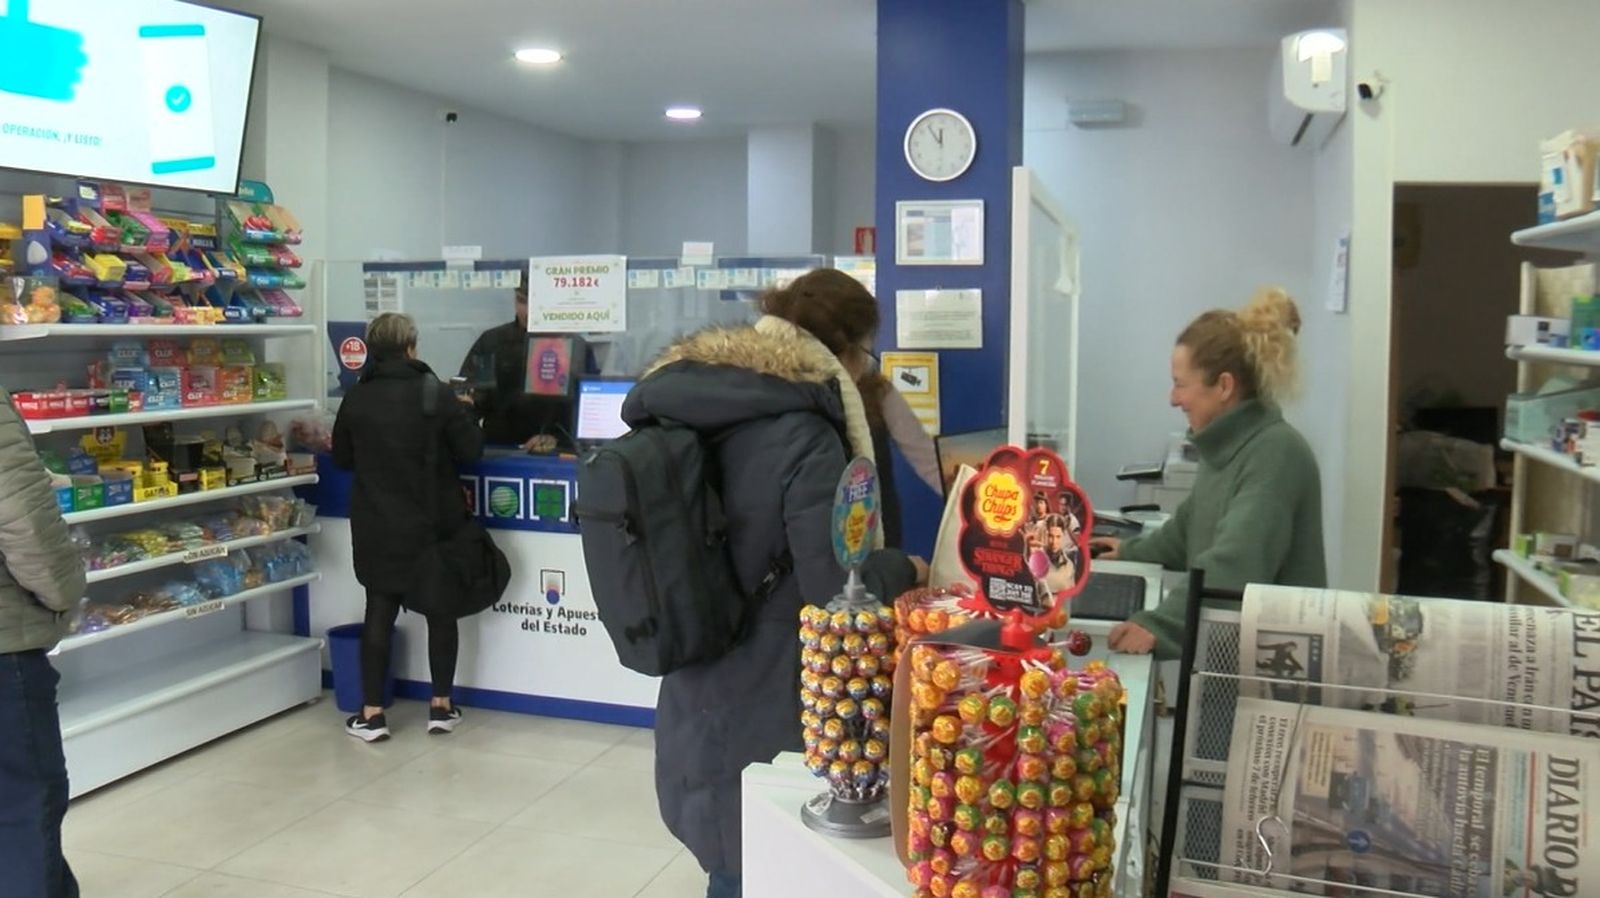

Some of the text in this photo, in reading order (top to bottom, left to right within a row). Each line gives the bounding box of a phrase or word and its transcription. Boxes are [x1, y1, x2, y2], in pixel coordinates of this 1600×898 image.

[545, 265, 610, 275] GRAN PREMIO
[542, 309, 610, 322] VENDIDO AQUÍ
[1038, 460, 1050, 475] 7
[984, 485, 1020, 501] Chupa
[982, 499, 1018, 517] Chups
[492, 602, 542, 616] Loterías
[546, 608, 553, 619] y
[521, 619, 587, 636] del Estado
[1573, 612, 1600, 659] EL
[1523, 666, 1540, 693] Irán
[1459, 749, 1472, 763] la
[1475, 748, 1489, 763] El
[1257, 780, 1270, 814] Madrid
[1454, 764, 1470, 817] autovía
[1465, 766, 1487, 829] temporal
[1543, 753, 1581, 870] DIARIO
[1452, 818, 1470, 857] hacia
[1471, 834, 1482, 850] se
